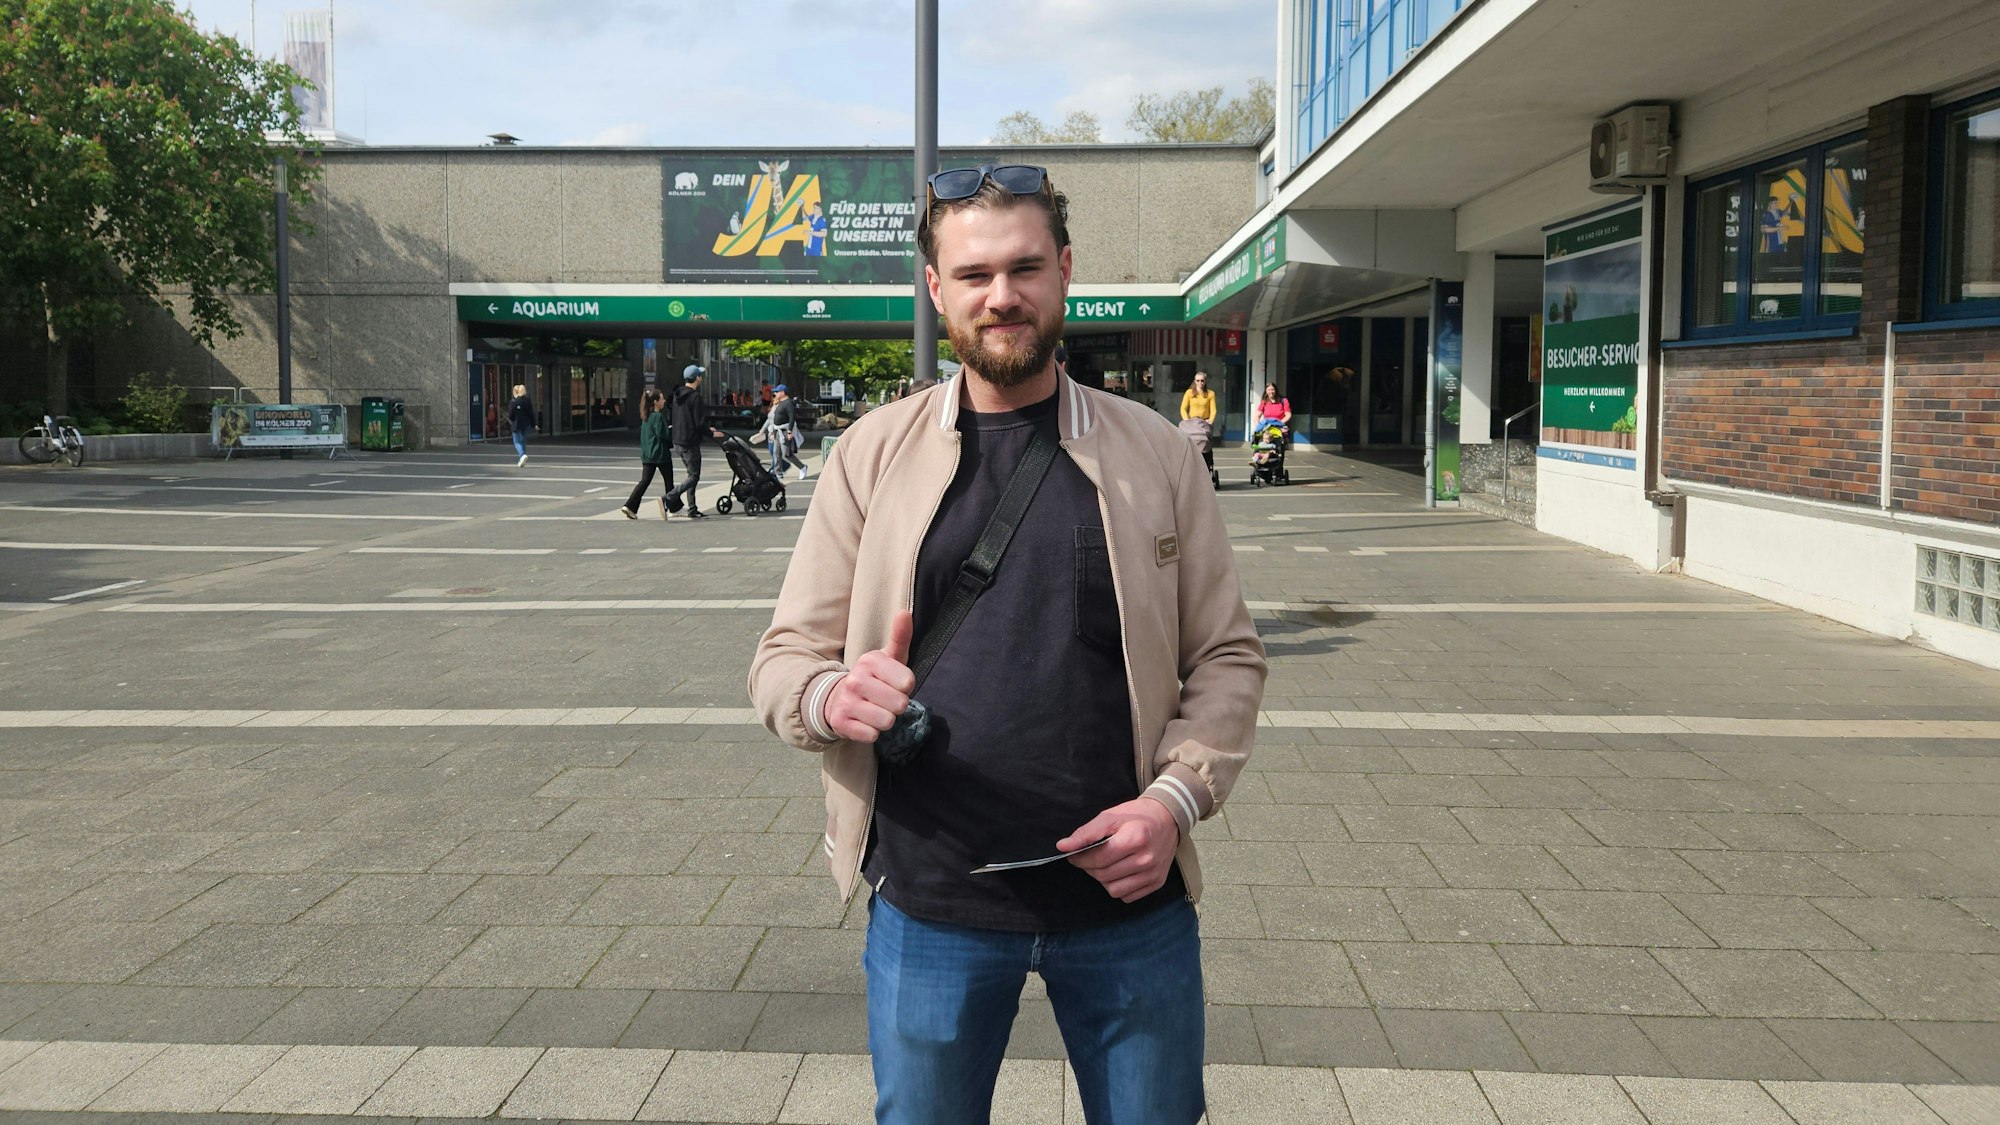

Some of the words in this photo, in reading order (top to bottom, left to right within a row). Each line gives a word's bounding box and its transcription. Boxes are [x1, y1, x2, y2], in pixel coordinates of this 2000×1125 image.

[712, 174, 746, 186] DEIN
[829, 200, 857, 215] FÜR
[858, 203, 881, 215] DIE
[830, 216, 850, 228] ZU
[851, 216, 888, 228] GAST
[888, 216, 904, 228] IN
[833, 230, 896, 242] UNSEREN
[897, 230, 915, 242] VE
[905, 250, 915, 258] Sp
[512, 301, 599, 318] AQUARIUM
[1076, 301, 1126, 317] EVENT
[1547, 341, 1640, 368] BESUCHER-SERVIC
[1564, 387, 1588, 396] HERZLICH
[1589, 387, 1625, 396] WILLKOMMEN
[255, 411, 311, 419] DINOWORLD
[266, 418, 295, 427] KÖLNER
